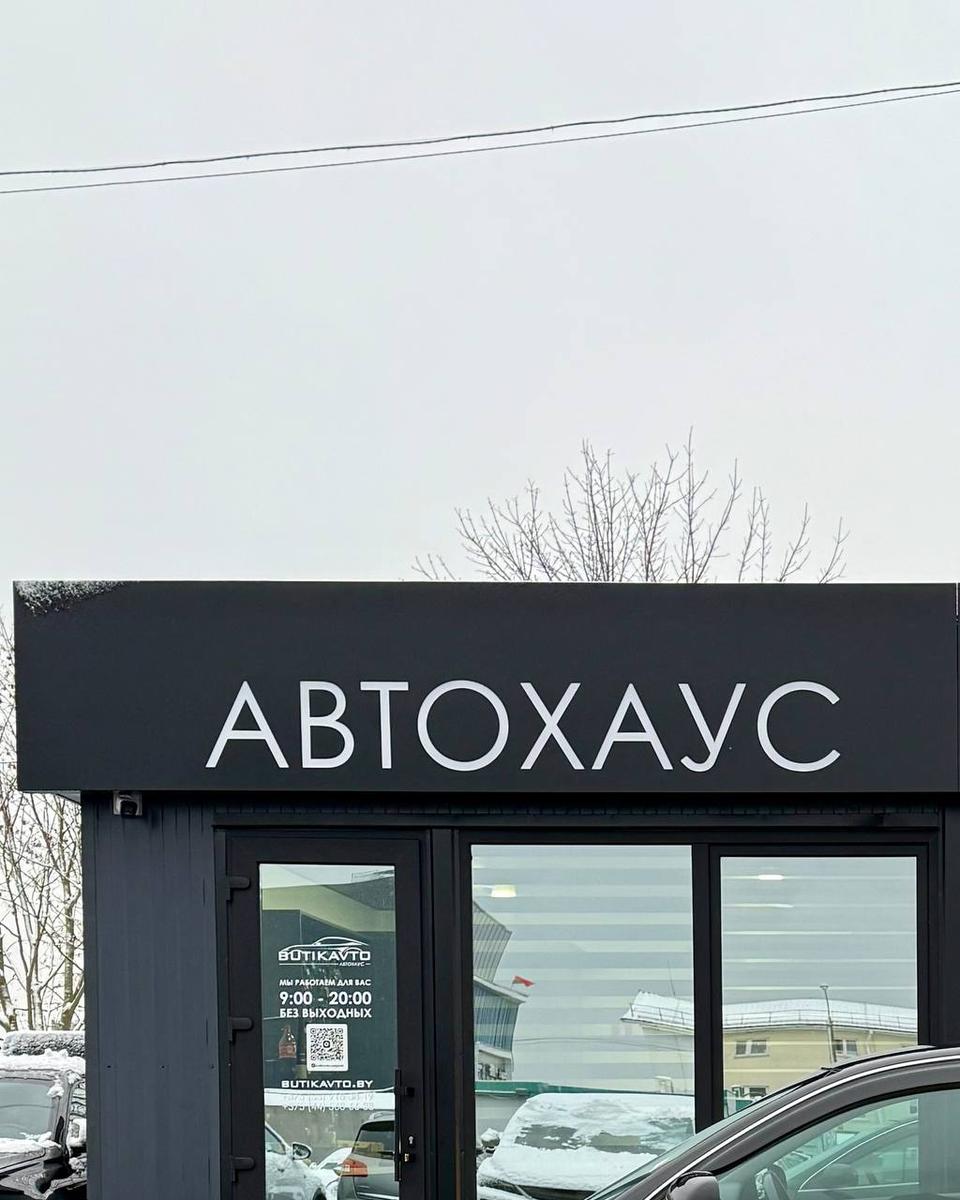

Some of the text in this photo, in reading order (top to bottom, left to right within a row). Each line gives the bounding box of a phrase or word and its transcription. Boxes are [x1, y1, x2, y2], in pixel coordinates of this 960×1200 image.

[205, 680, 841, 772] АВТОХАУС
[278, 950, 371, 961] BUTIKAVTO
[336, 979, 354, 987] ДЛЯ
[279, 991, 313, 1005] 9:00
[328, 991, 372, 1005] 20:00
[279, 1008, 372, 1019] БЕЗ ВЫХОДНЫХ
[281, 1080, 373, 1088] BUTIKAVTO.BY
